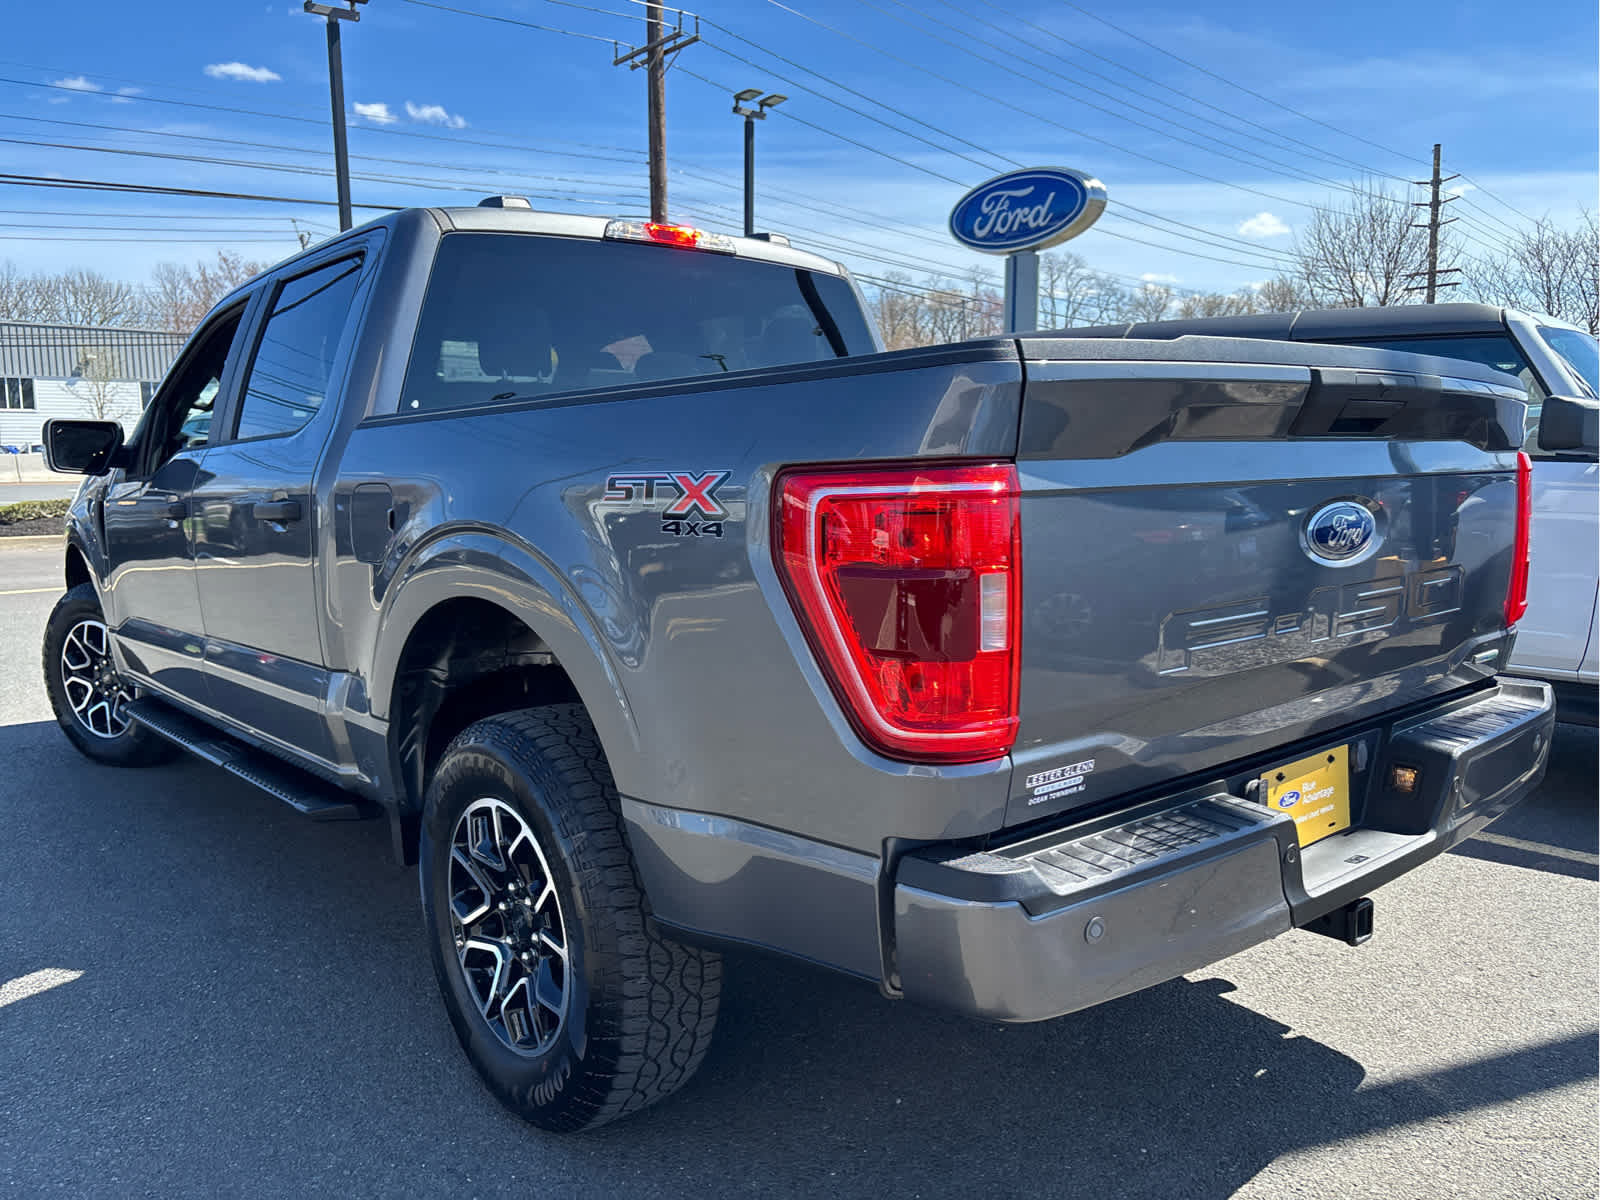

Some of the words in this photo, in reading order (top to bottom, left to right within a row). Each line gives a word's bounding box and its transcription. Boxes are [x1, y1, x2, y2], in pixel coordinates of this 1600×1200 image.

[972, 185, 1056, 238] Ford
[603, 471, 733, 521] STX
[1327, 514, 1366, 546] Ford
[1027, 770, 1062, 786] LESTER
[1063, 761, 1094, 776] GLENN
[1303, 782, 1316, 792] Blue
[1303, 786, 1334, 803] Advantage
